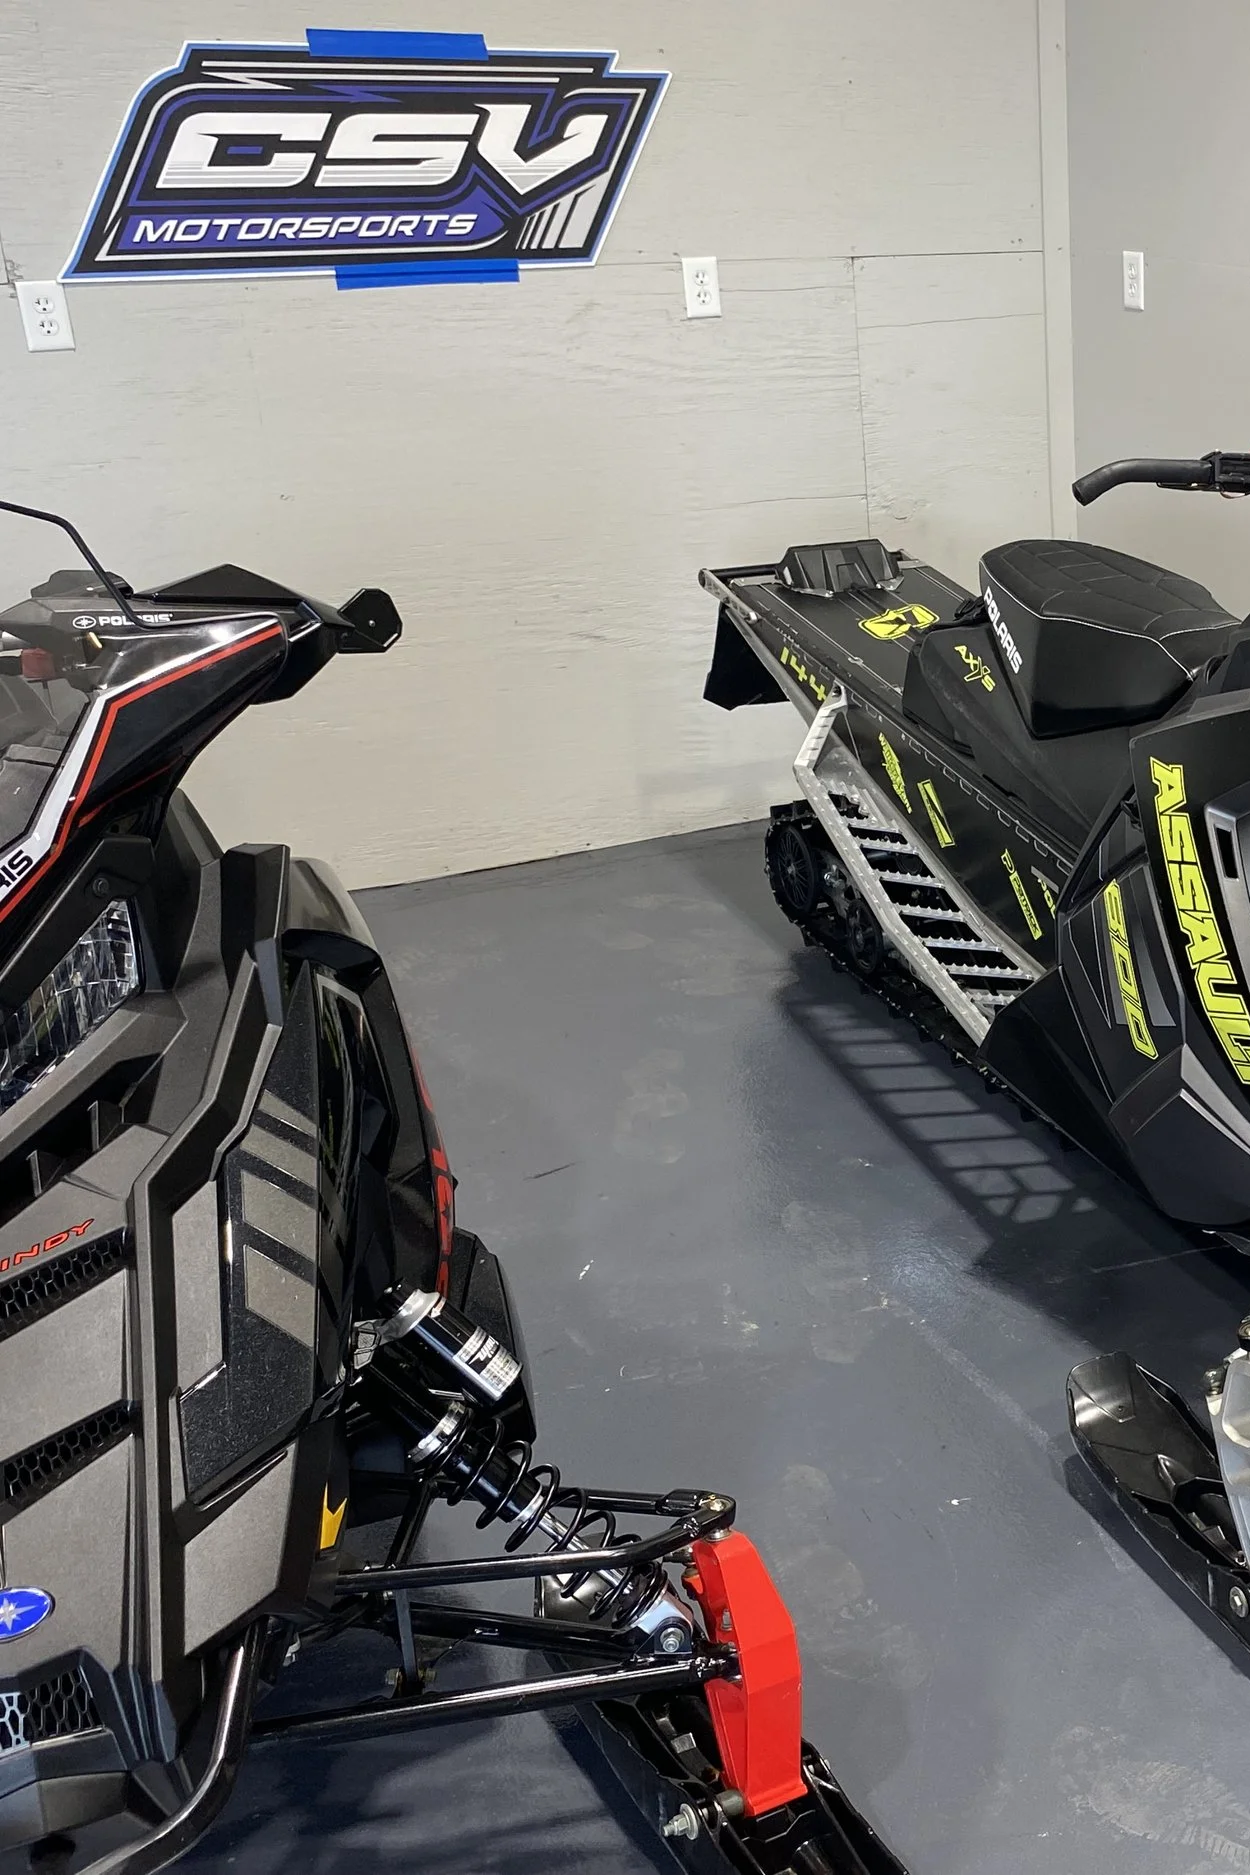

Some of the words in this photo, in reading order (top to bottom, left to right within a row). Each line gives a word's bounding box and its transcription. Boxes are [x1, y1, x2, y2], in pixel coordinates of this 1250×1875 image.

[156, 104, 608, 195] CSV
[132, 214, 478, 244] MOTORSPORTS
[983, 585, 1023, 674] POLARIS
[780, 646, 827, 701] 144
[0, 1218, 95, 1273] INDY
